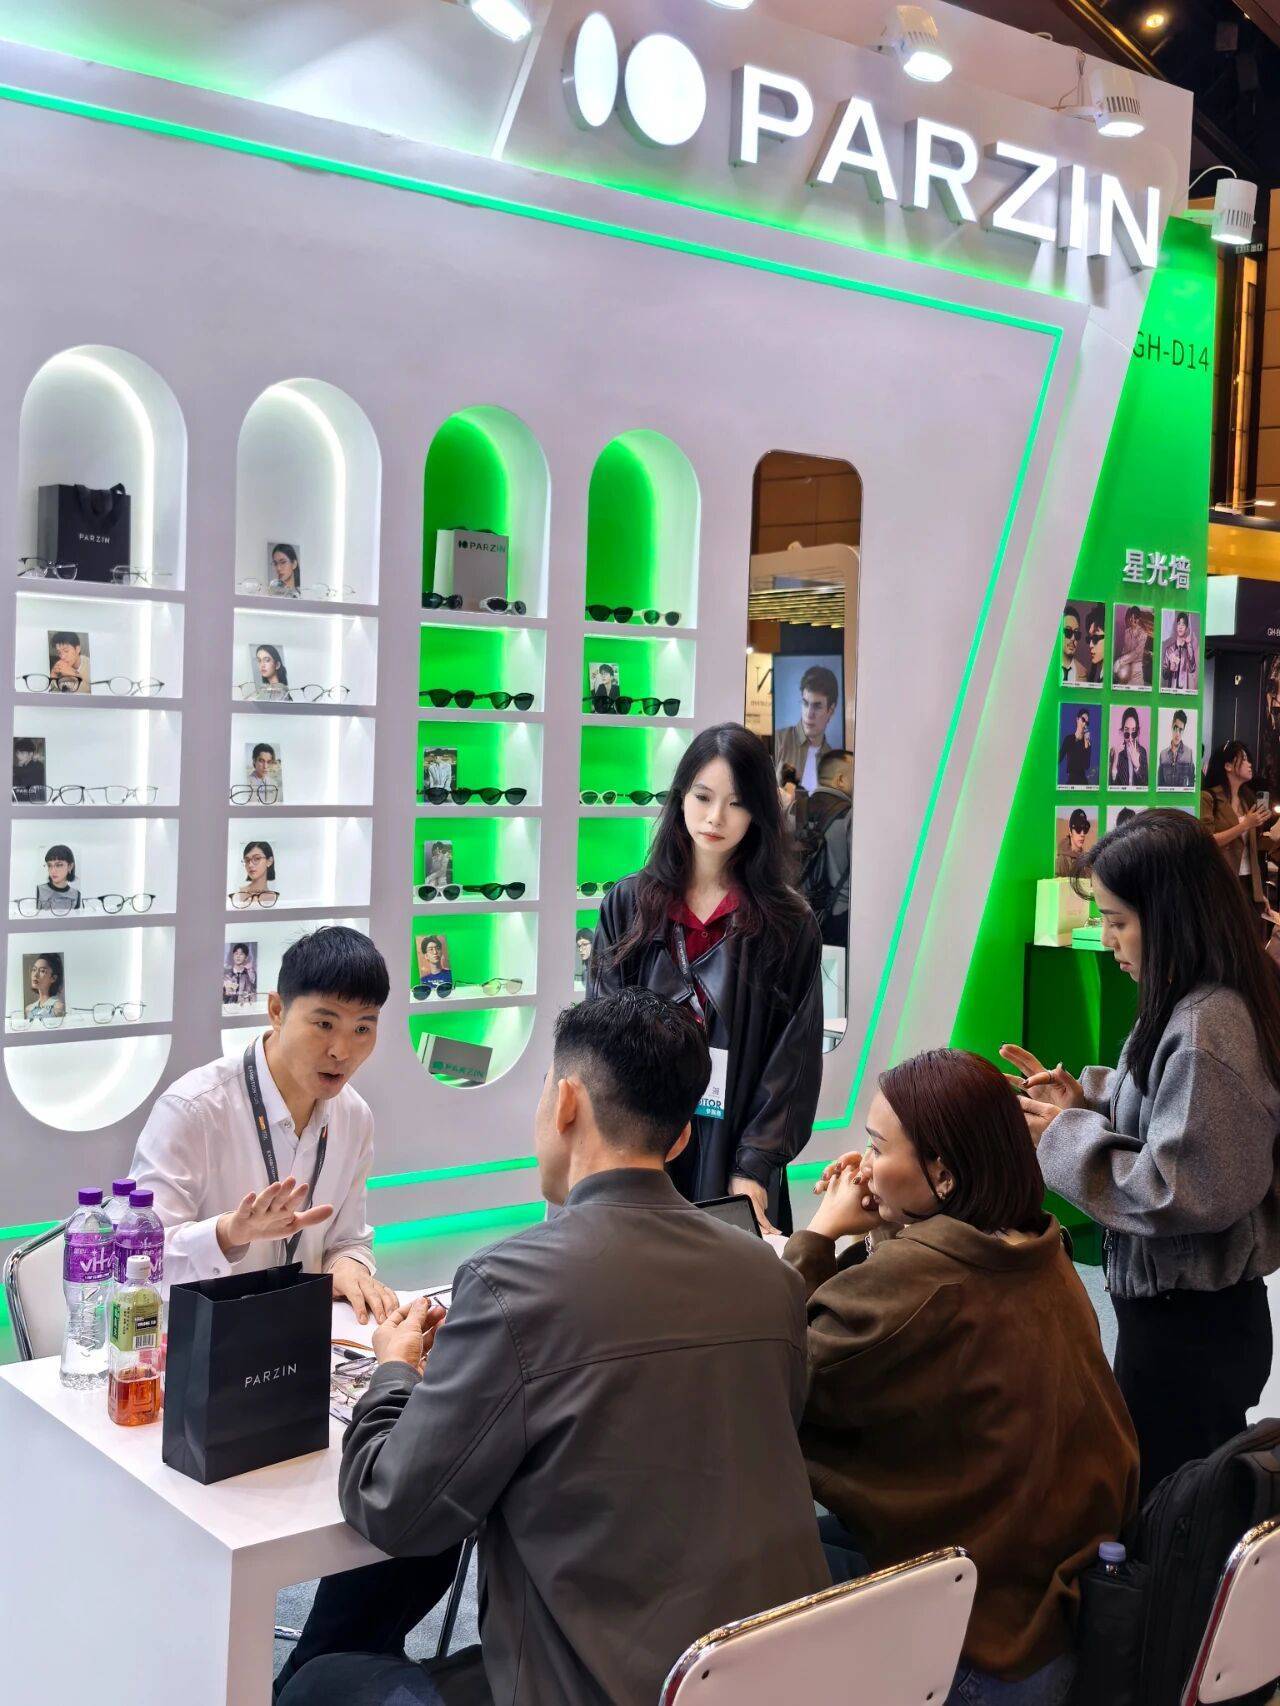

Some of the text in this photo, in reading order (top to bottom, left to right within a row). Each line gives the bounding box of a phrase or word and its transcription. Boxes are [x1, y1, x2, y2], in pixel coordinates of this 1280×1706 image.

[738, 64, 1160, 269] PARZIN
[1133, 331, 1210, 373] GH-D14
[78, 532, 111, 544] PARZIN
[469, 541, 506, 552] PARZIN
[1121, 547, 1192, 590] 星光墙
[244, 1362, 298, 1388] PARZIN
